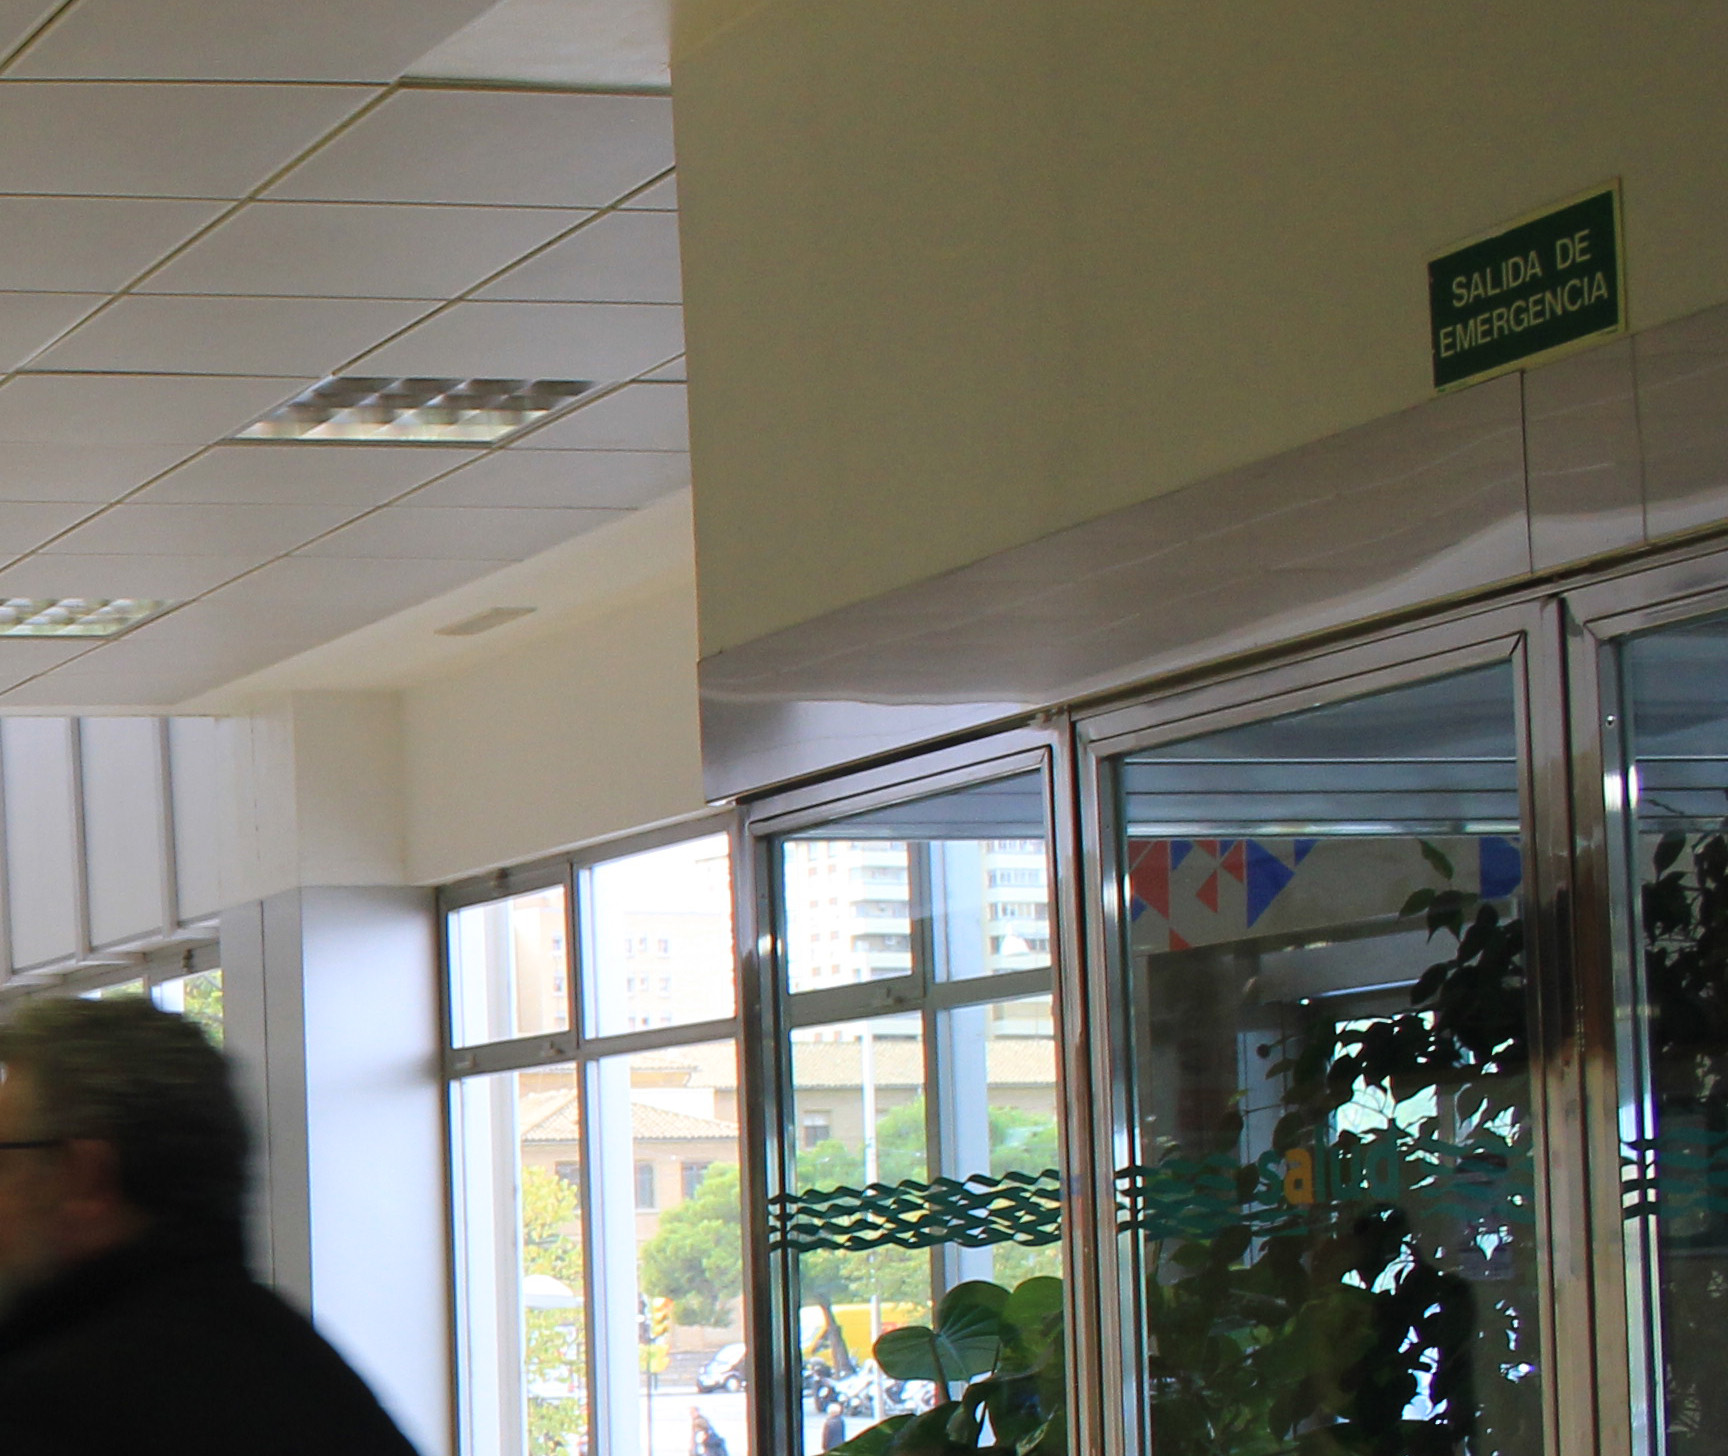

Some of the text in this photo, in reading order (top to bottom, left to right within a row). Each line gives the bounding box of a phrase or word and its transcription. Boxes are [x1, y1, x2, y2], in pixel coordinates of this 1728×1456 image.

[1452, 229, 1592, 308] SALIDA DE
[1440, 271, 1609, 358] EMERGENCIA
[1254, 1117, 1400, 1205] salud
